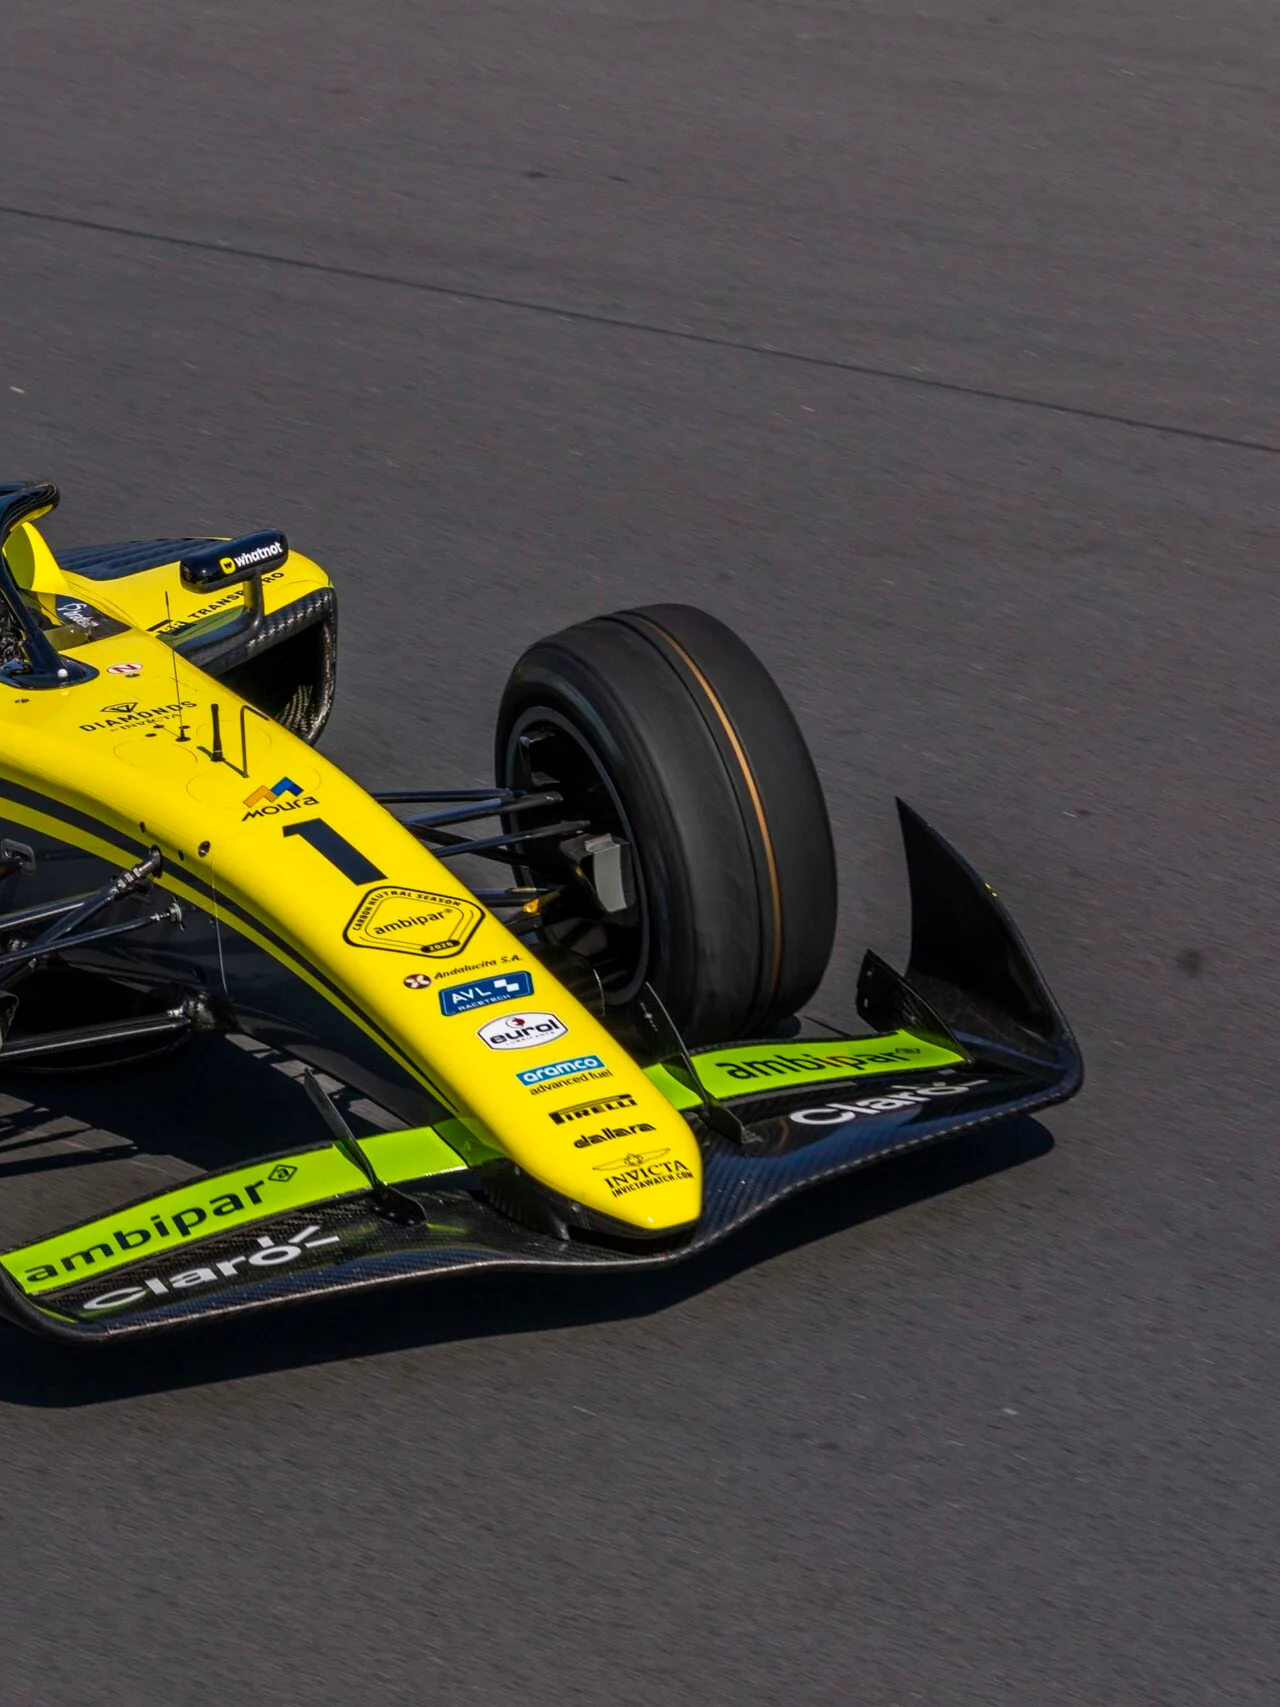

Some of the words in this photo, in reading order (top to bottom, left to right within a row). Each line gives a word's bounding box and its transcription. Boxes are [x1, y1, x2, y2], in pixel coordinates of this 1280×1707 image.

[234, 541, 283, 567] whatnot
[188, 572, 284, 619] TRANSPRO
[79, 701, 197, 732] DIAMONDS
[282, 817, 388, 886] 1
[352, 905, 372, 931] CARBON
[368, 890, 412, 908] NEUTRAL
[416, 893, 460, 906] SEASON
[373, 910, 445, 935] ambipar
[451, 987, 492, 1005] AVL
[458, 994, 511, 1011] RACETECH
[490, 1019, 560, 1044] eurol
[523, 1058, 598, 1082] aramco
[715, 1050, 911, 1081] ambipar
[530, 1073, 590, 1096] advanced
[587, 1068, 614, 1080] fuel
[548, 1094, 638, 1125] PIRELLI
[574, 1122, 657, 1149] dallara
[604, 1159, 689, 1189] INVICTA
[611, 1171, 694, 1198] INVICTAWATCH.COM
[25, 1175, 265, 1284] ambipar
